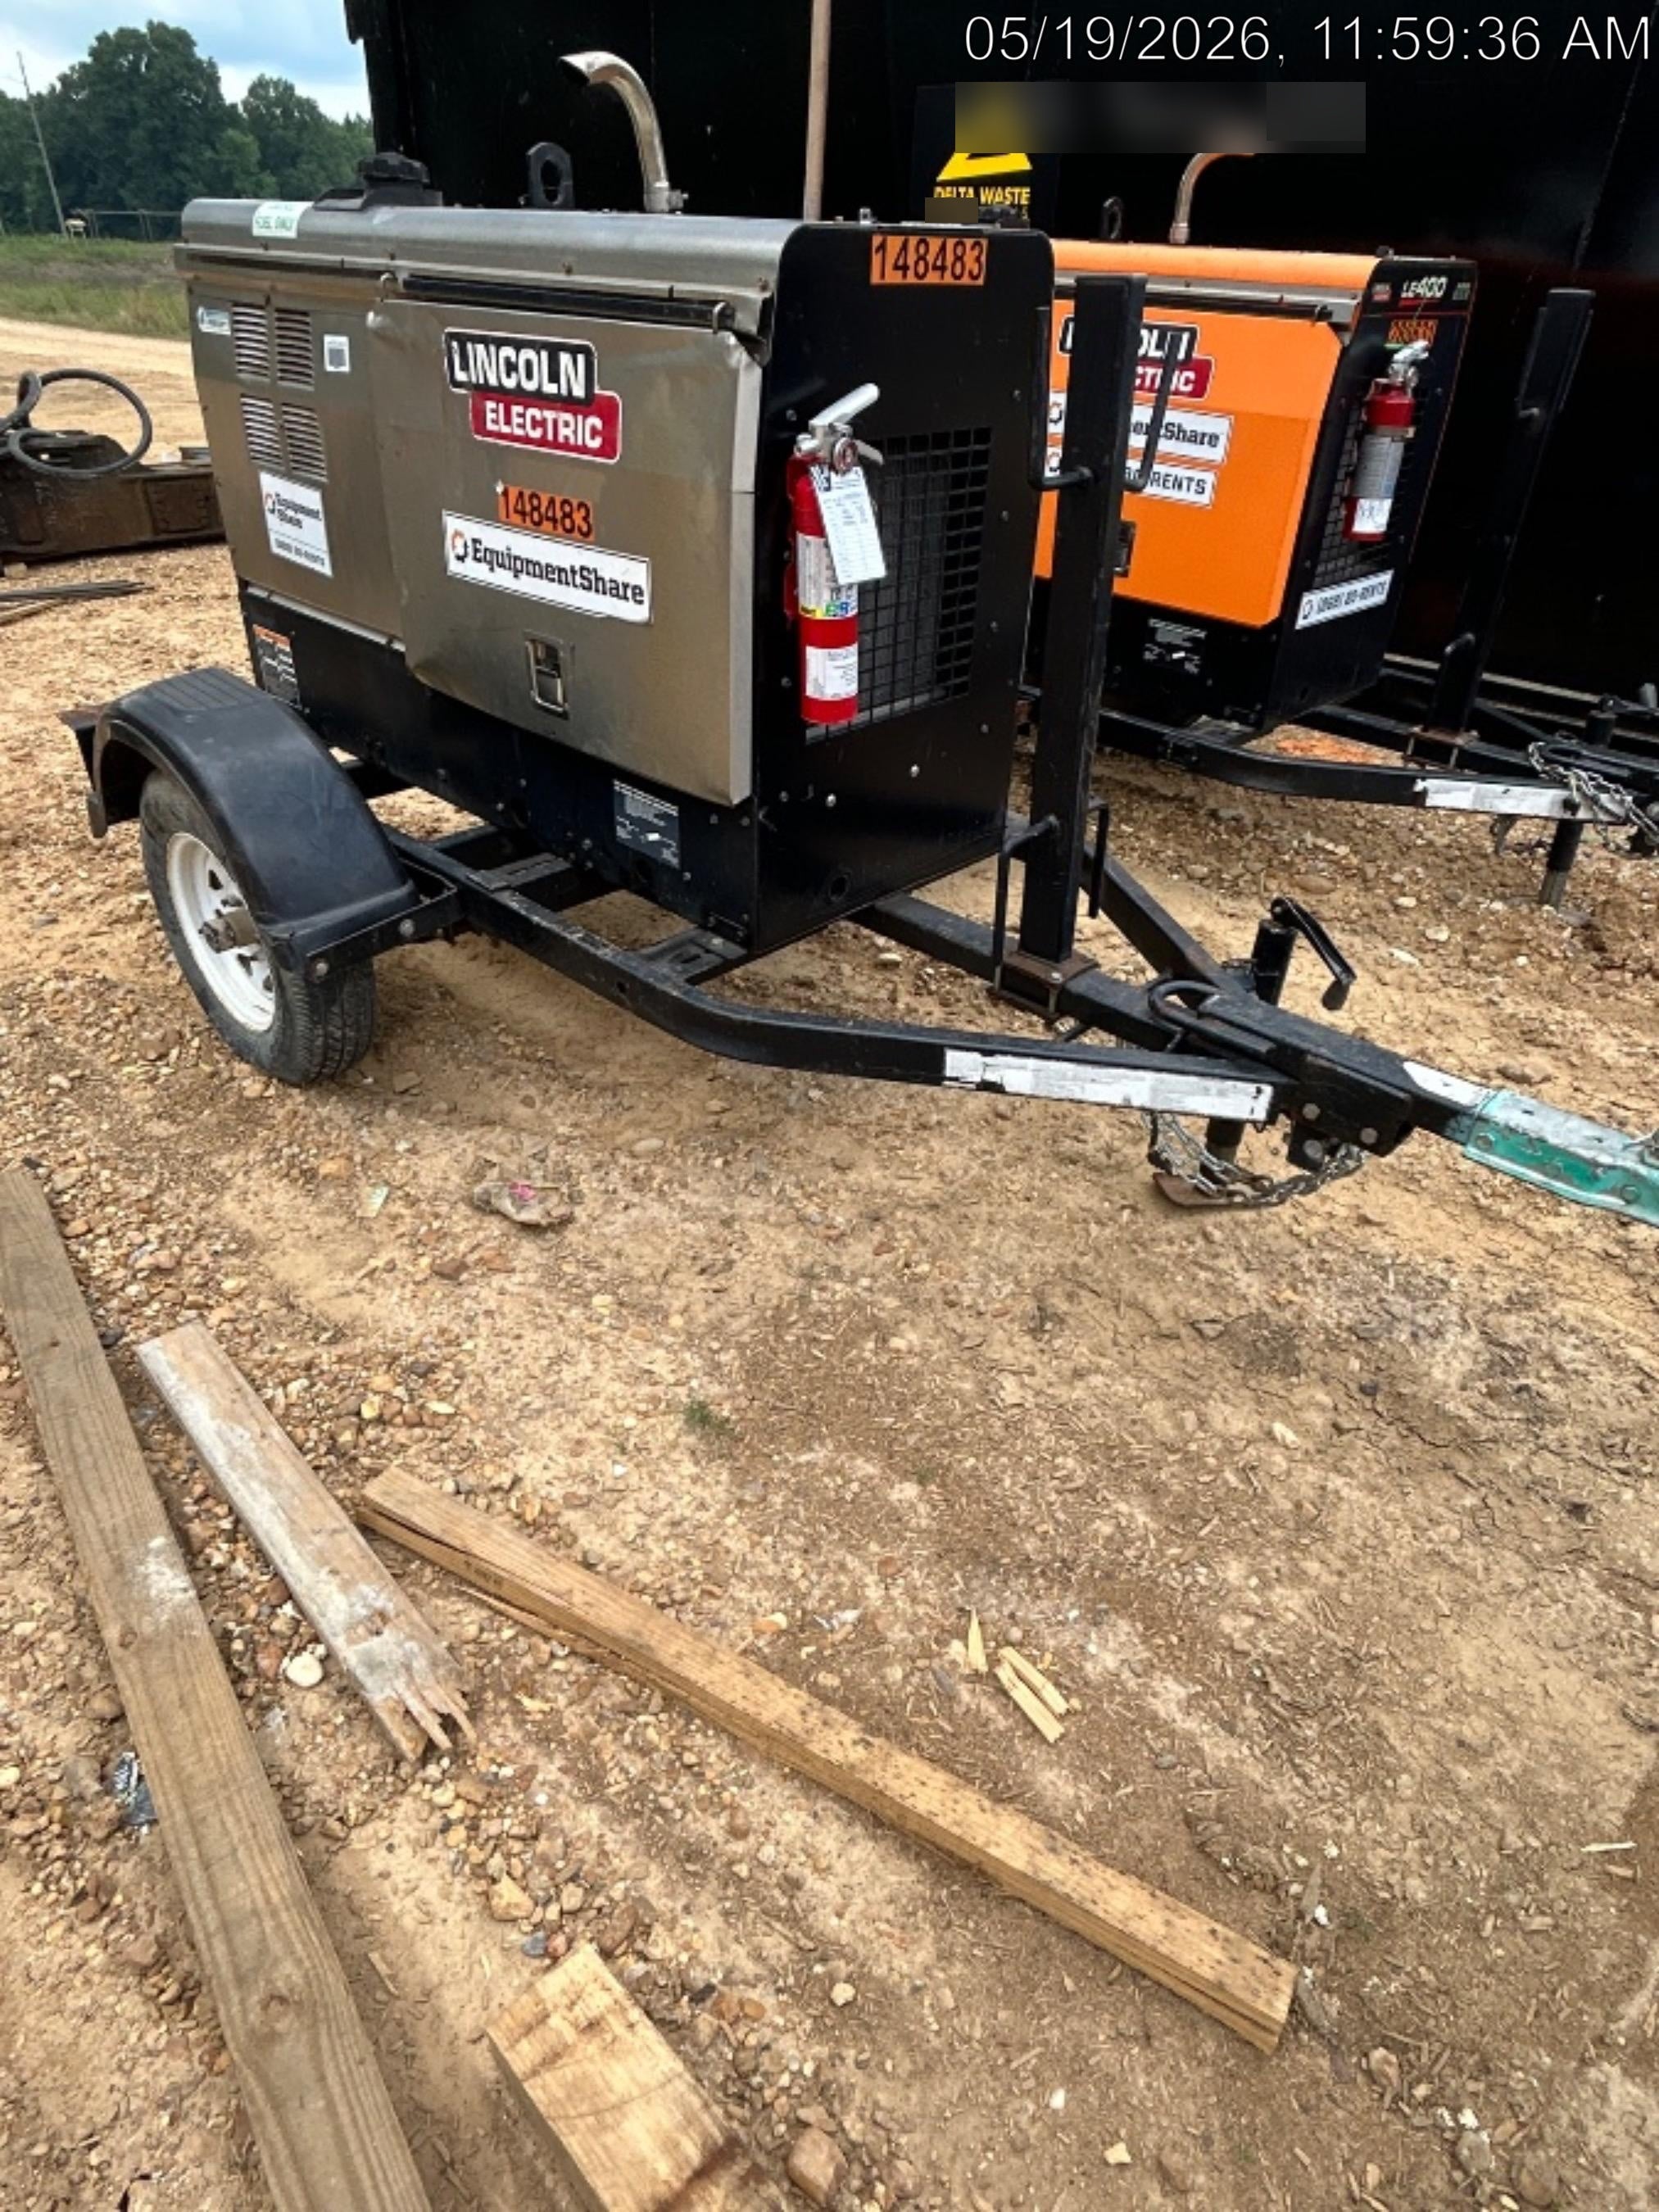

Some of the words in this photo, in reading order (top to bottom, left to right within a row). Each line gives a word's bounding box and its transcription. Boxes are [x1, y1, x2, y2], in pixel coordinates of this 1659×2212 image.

[980, 186, 1031, 205] WASTE
[875, 237, 983, 280] 148483
[452, 341, 587, 398] LINCOLN
[485, 401, 604, 448] ELECTRIC
[501, 487, 593, 538] 148483
[471, 537, 645, 605] EquipmentShare
